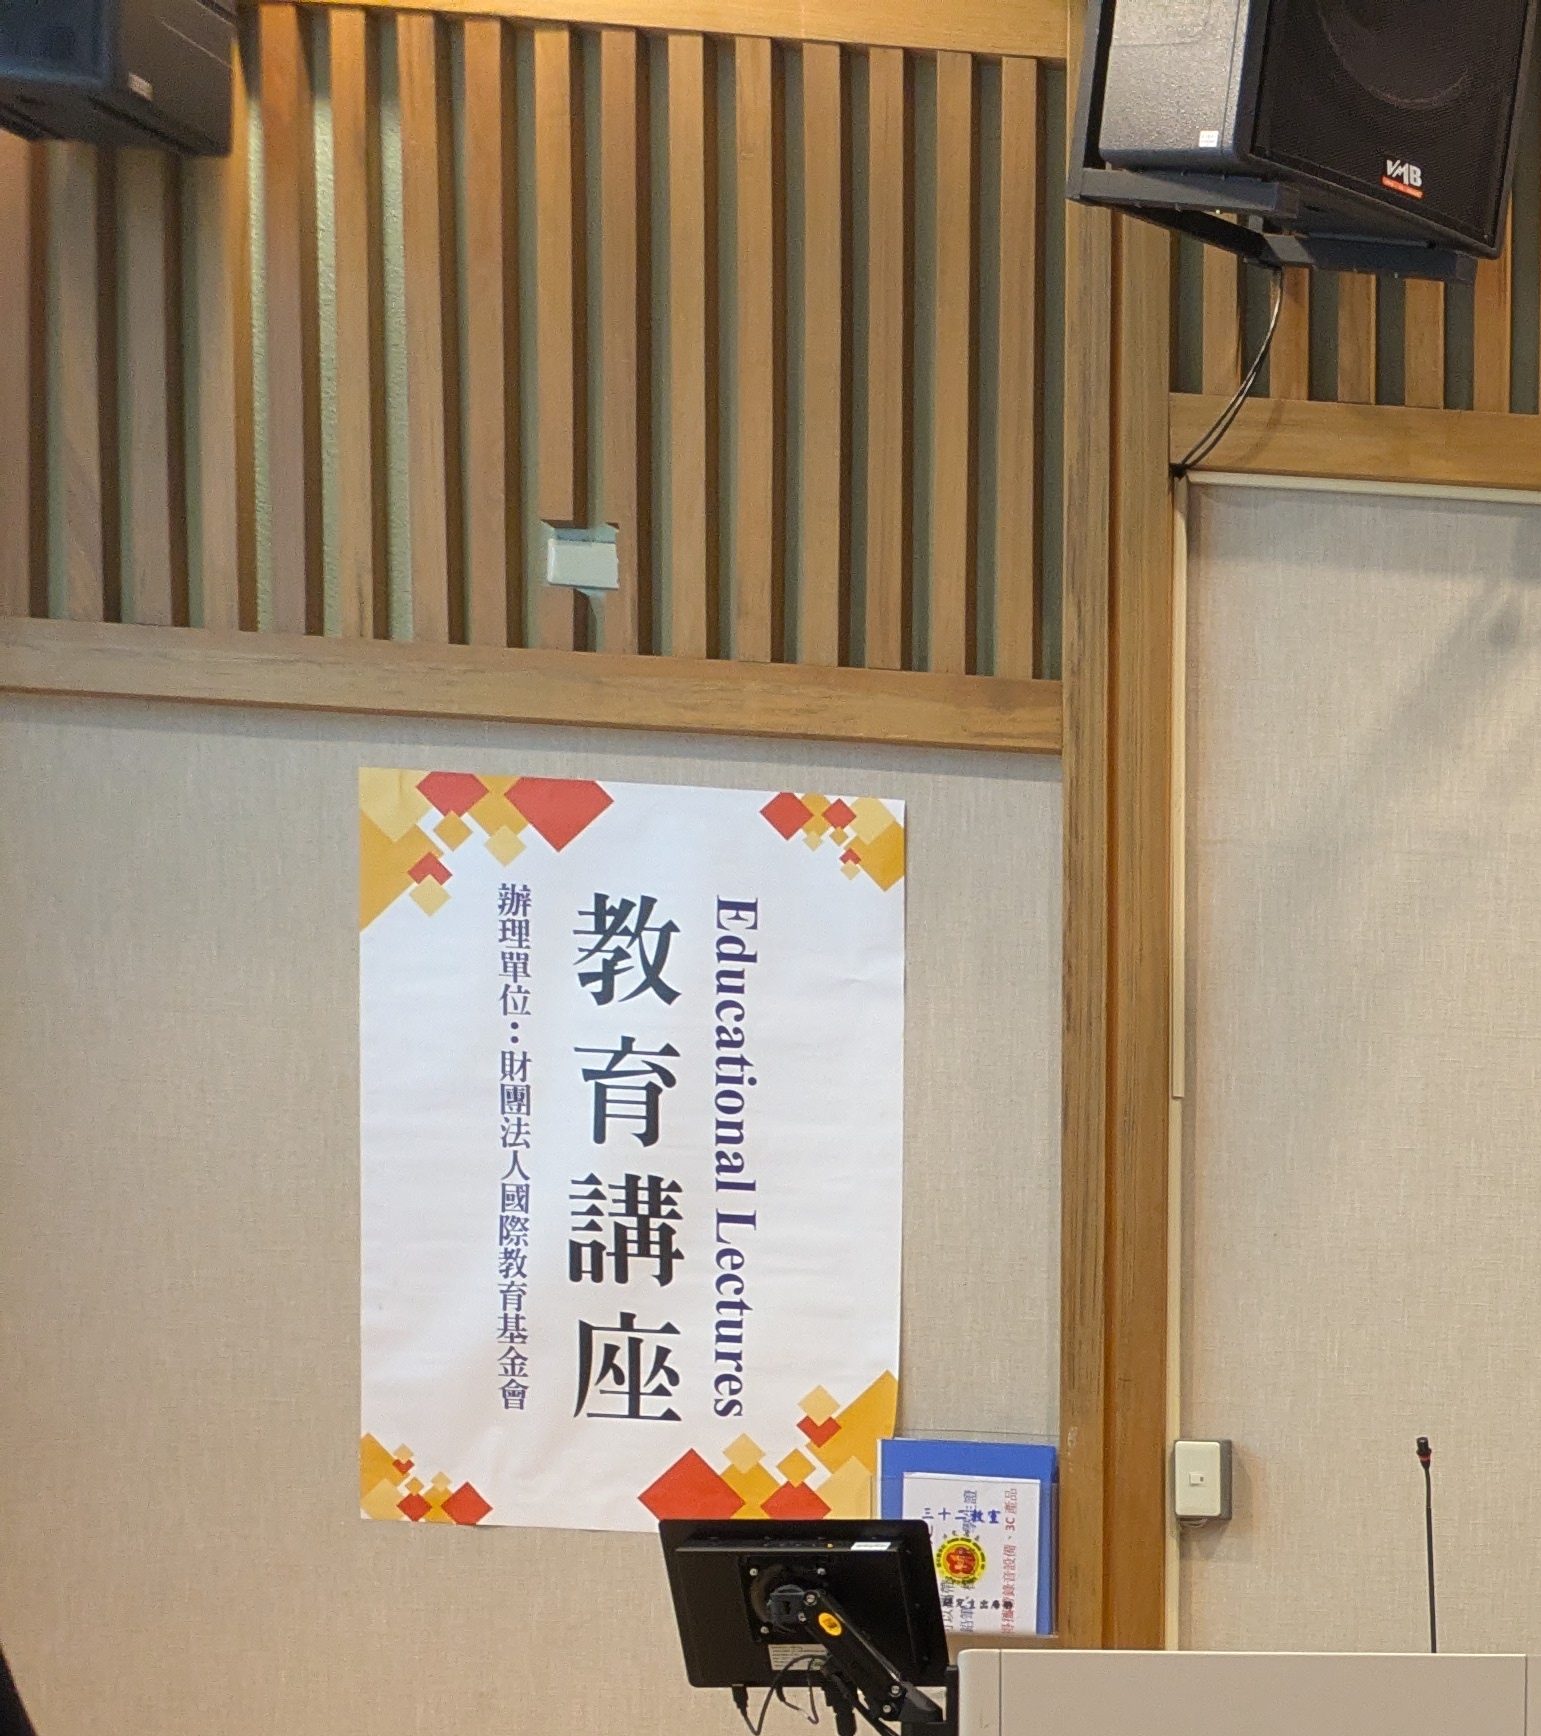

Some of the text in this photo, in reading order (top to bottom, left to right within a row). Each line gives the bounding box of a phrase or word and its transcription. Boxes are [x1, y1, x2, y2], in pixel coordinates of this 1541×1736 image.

[1386, 159, 1422, 187] VMB
[568, 891, 685, 1422] 教育講座
[713, 895, 759, 1418] Educational Lectures
